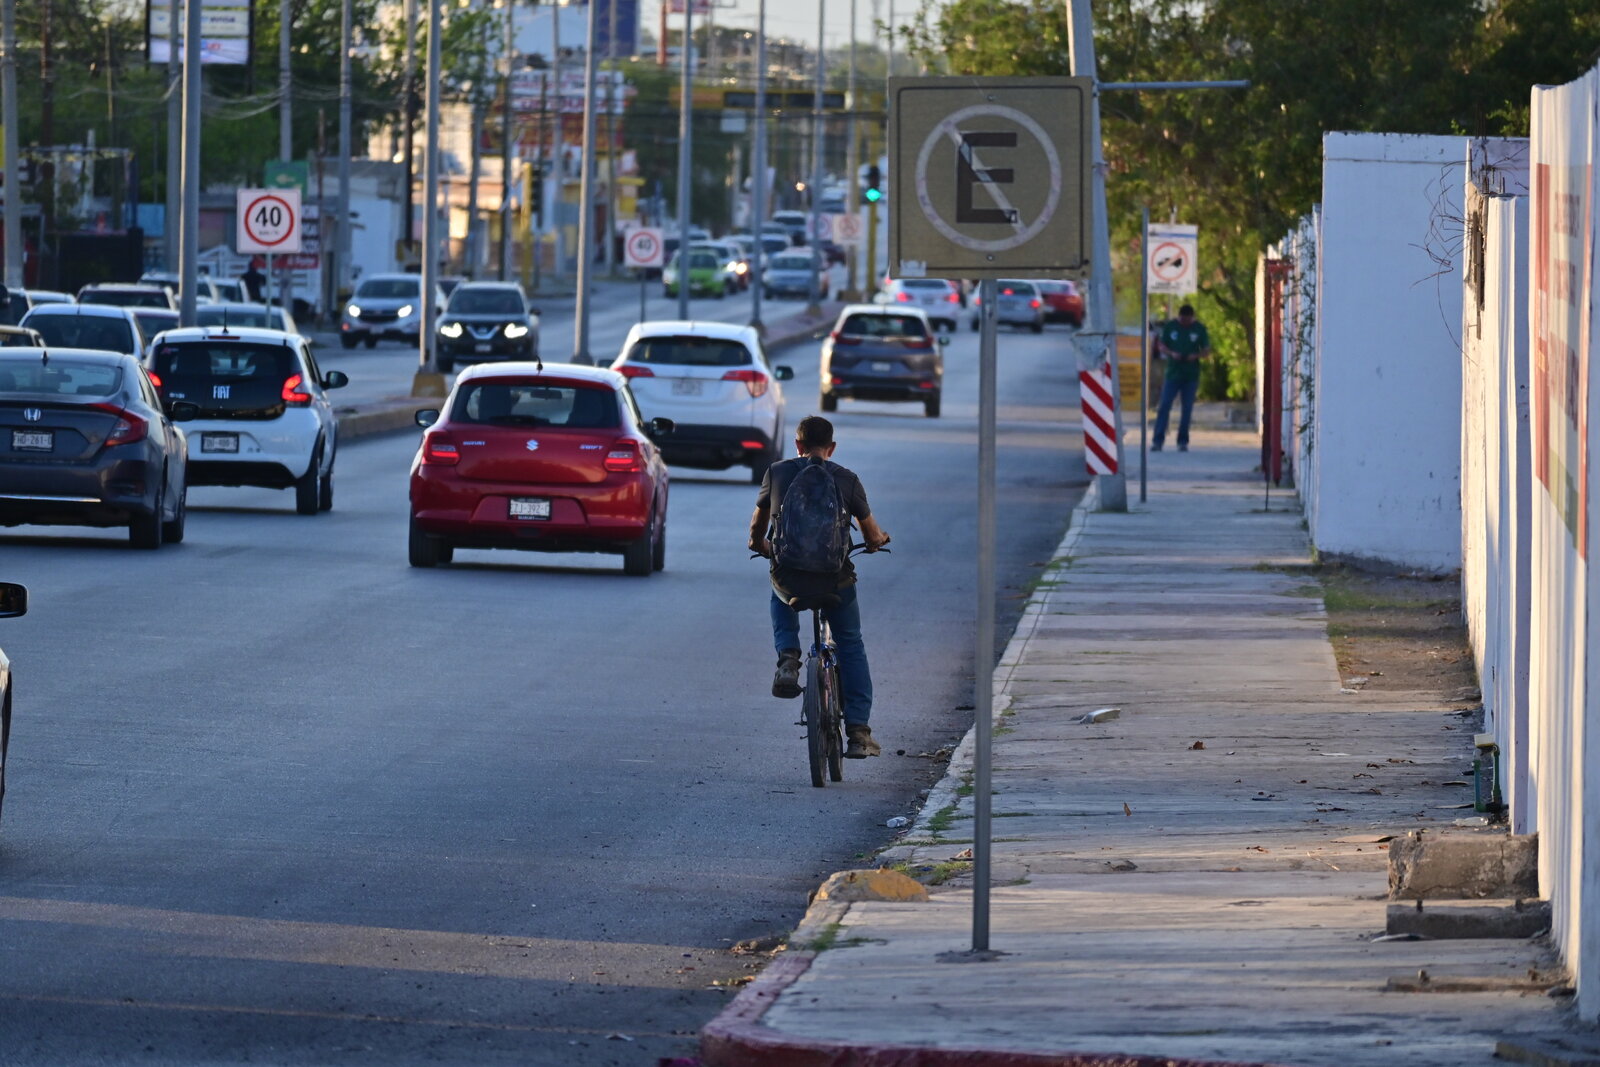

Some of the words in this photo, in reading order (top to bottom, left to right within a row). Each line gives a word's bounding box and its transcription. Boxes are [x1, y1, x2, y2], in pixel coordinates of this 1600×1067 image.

[955, 131, 1018, 224] E
[255, 205, 282, 228] 40
[638, 238, 651, 251] 40
[212, 385, 231, 400] FIAT
